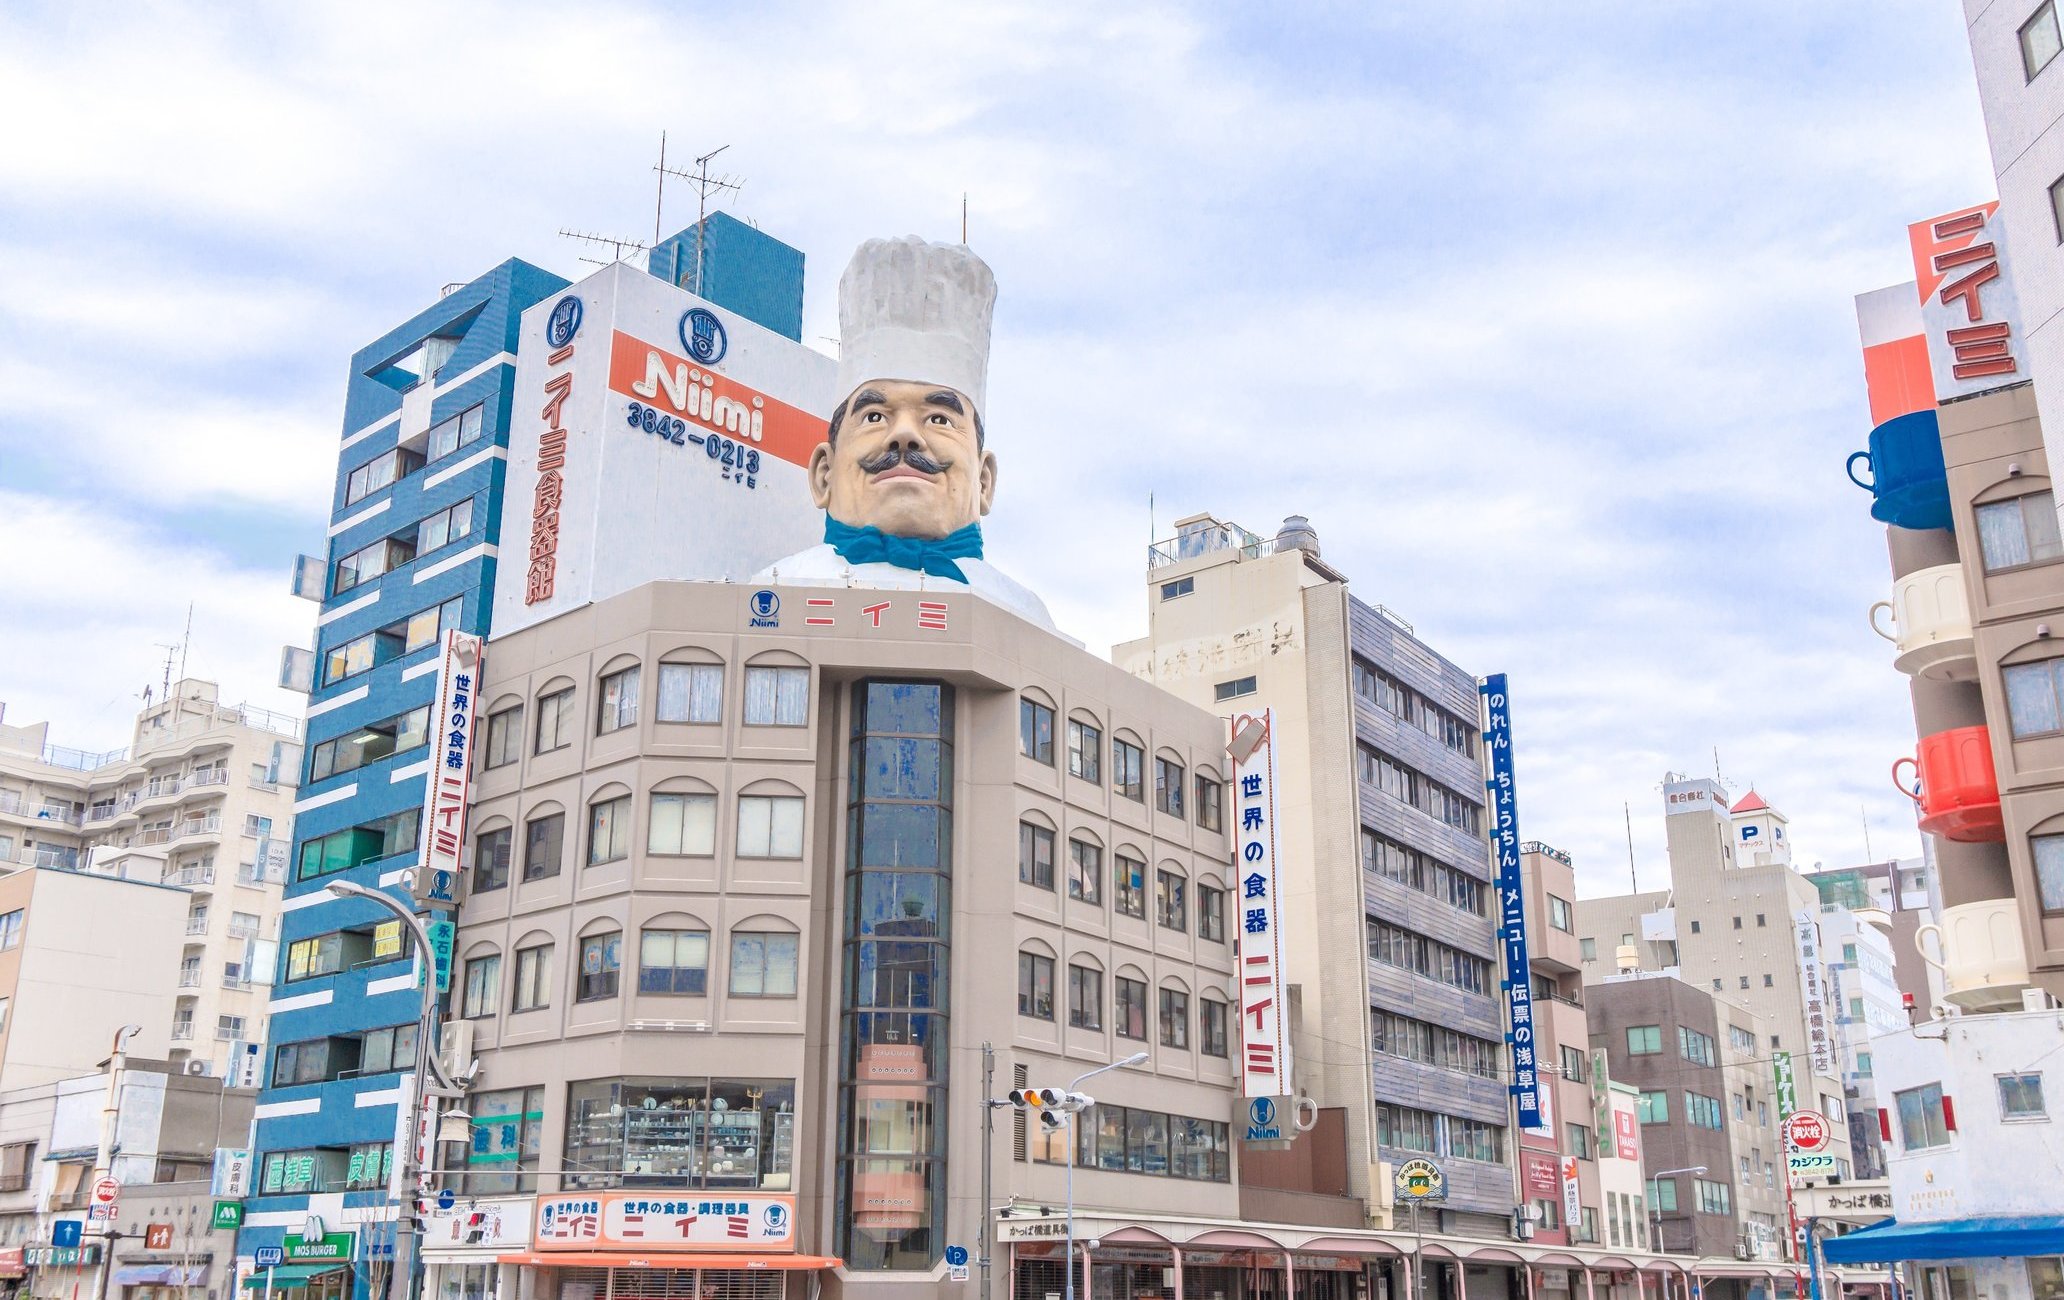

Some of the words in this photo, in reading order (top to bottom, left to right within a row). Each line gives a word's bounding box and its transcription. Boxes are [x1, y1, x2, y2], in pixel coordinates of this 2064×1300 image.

[1934, 211, 2016, 380] ニイミ
[631, 351, 764, 442] Niimi
[627, 401, 760, 474] 3842-0213
[525, 344, 575, 606] ニイミ食器館
[749, 618, 779, 628] Niimi
[805, 599, 948, 630] ニイミ
[447, 673, 471, 770] 世界の食器
[435, 777, 462, 857] ニイミ
[1742, 826, 1758, 840] P
[1241, 773, 1268, 934] 世界の食器
[428, 888, 453, 901] Niimi
[436, 923, 451, 988] 永石歯科
[1245, 955, 1275, 1075] ニイミ
[473, 1124, 516, 1152] 歯科
[1246, 1125, 1280, 1140] Niimi
[1792, 1125, 1821, 1140] 消火栓
[269, 1156, 314, 1189] 西浅草
[1790, 1155, 1833, 1168] カジワラ
[229, 1162, 242, 1194] 皮膚科
[557, 1201, 598, 1215] 世界の食器
[624, 1201, 749, 1215] 世界の食器・調理器具
[555, 1216, 597, 1238] ニイミ
[622, 1216, 749, 1238] ニイミ
[762, 1228, 786, 1236] Niimi
[294, 1246, 310, 1256] MOS
[311, 1244, 337, 1256] BURGER
